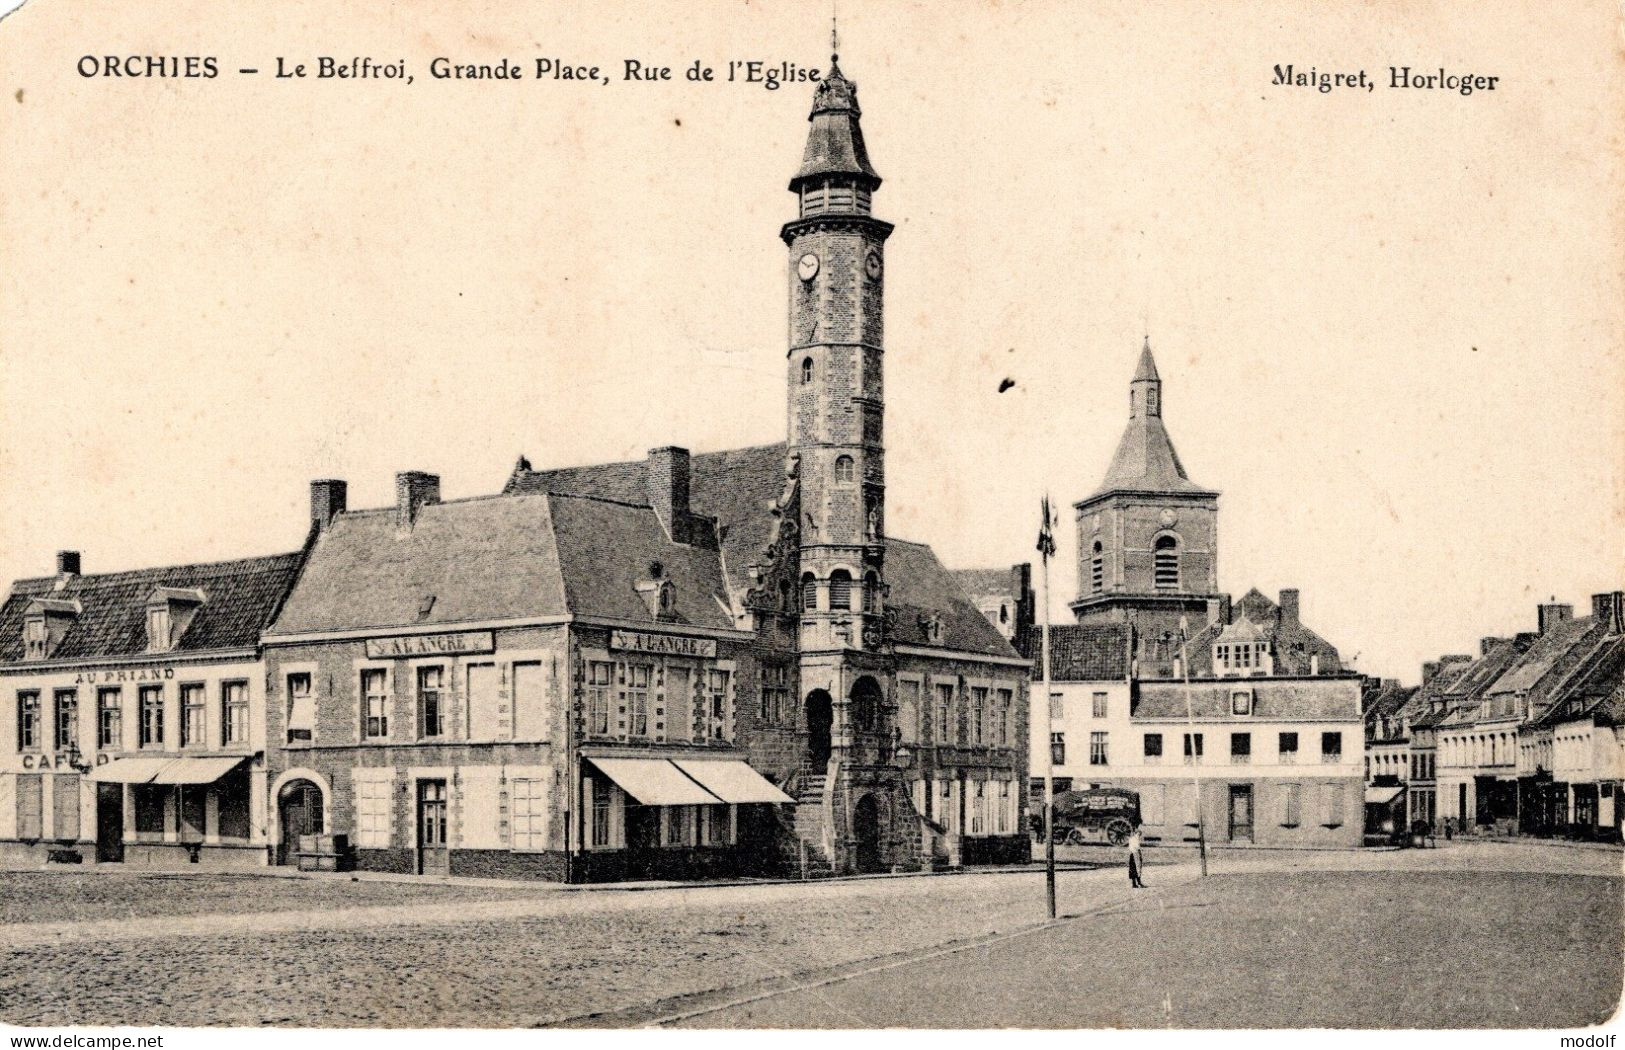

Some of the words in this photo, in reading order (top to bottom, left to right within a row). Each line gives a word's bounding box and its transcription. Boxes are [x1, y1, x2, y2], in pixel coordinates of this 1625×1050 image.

[75, 673, 97, 684] AU
[104, 668, 175, 682] FRIAND
[22, 754, 81, 770] CAF
